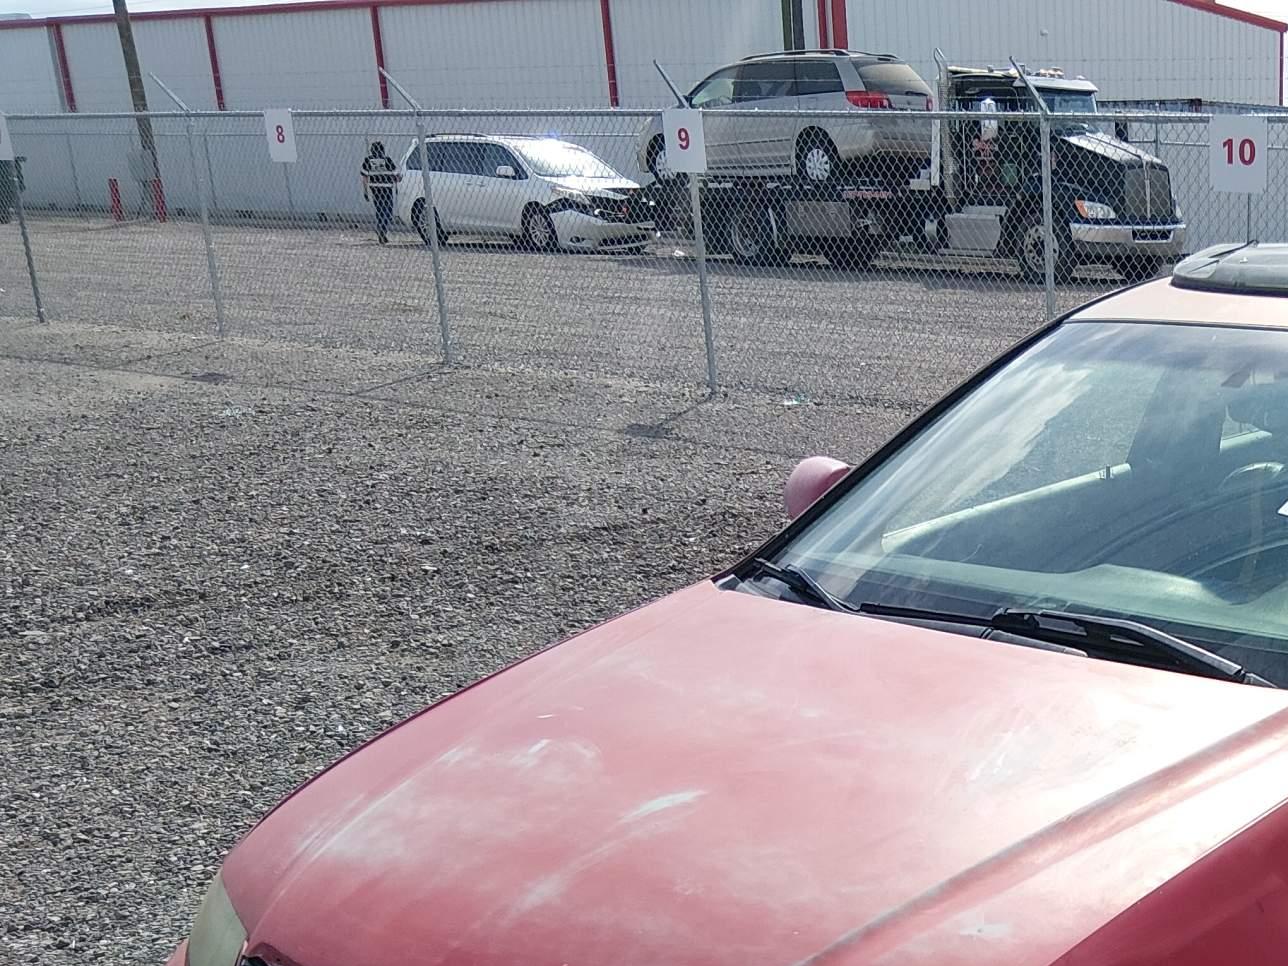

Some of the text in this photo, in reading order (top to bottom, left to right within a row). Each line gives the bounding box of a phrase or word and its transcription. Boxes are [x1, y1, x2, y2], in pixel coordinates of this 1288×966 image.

[275, 125, 285, 144] 8
[677, 128, 691, 150] 9
[1224, 138, 1255, 165] 10
